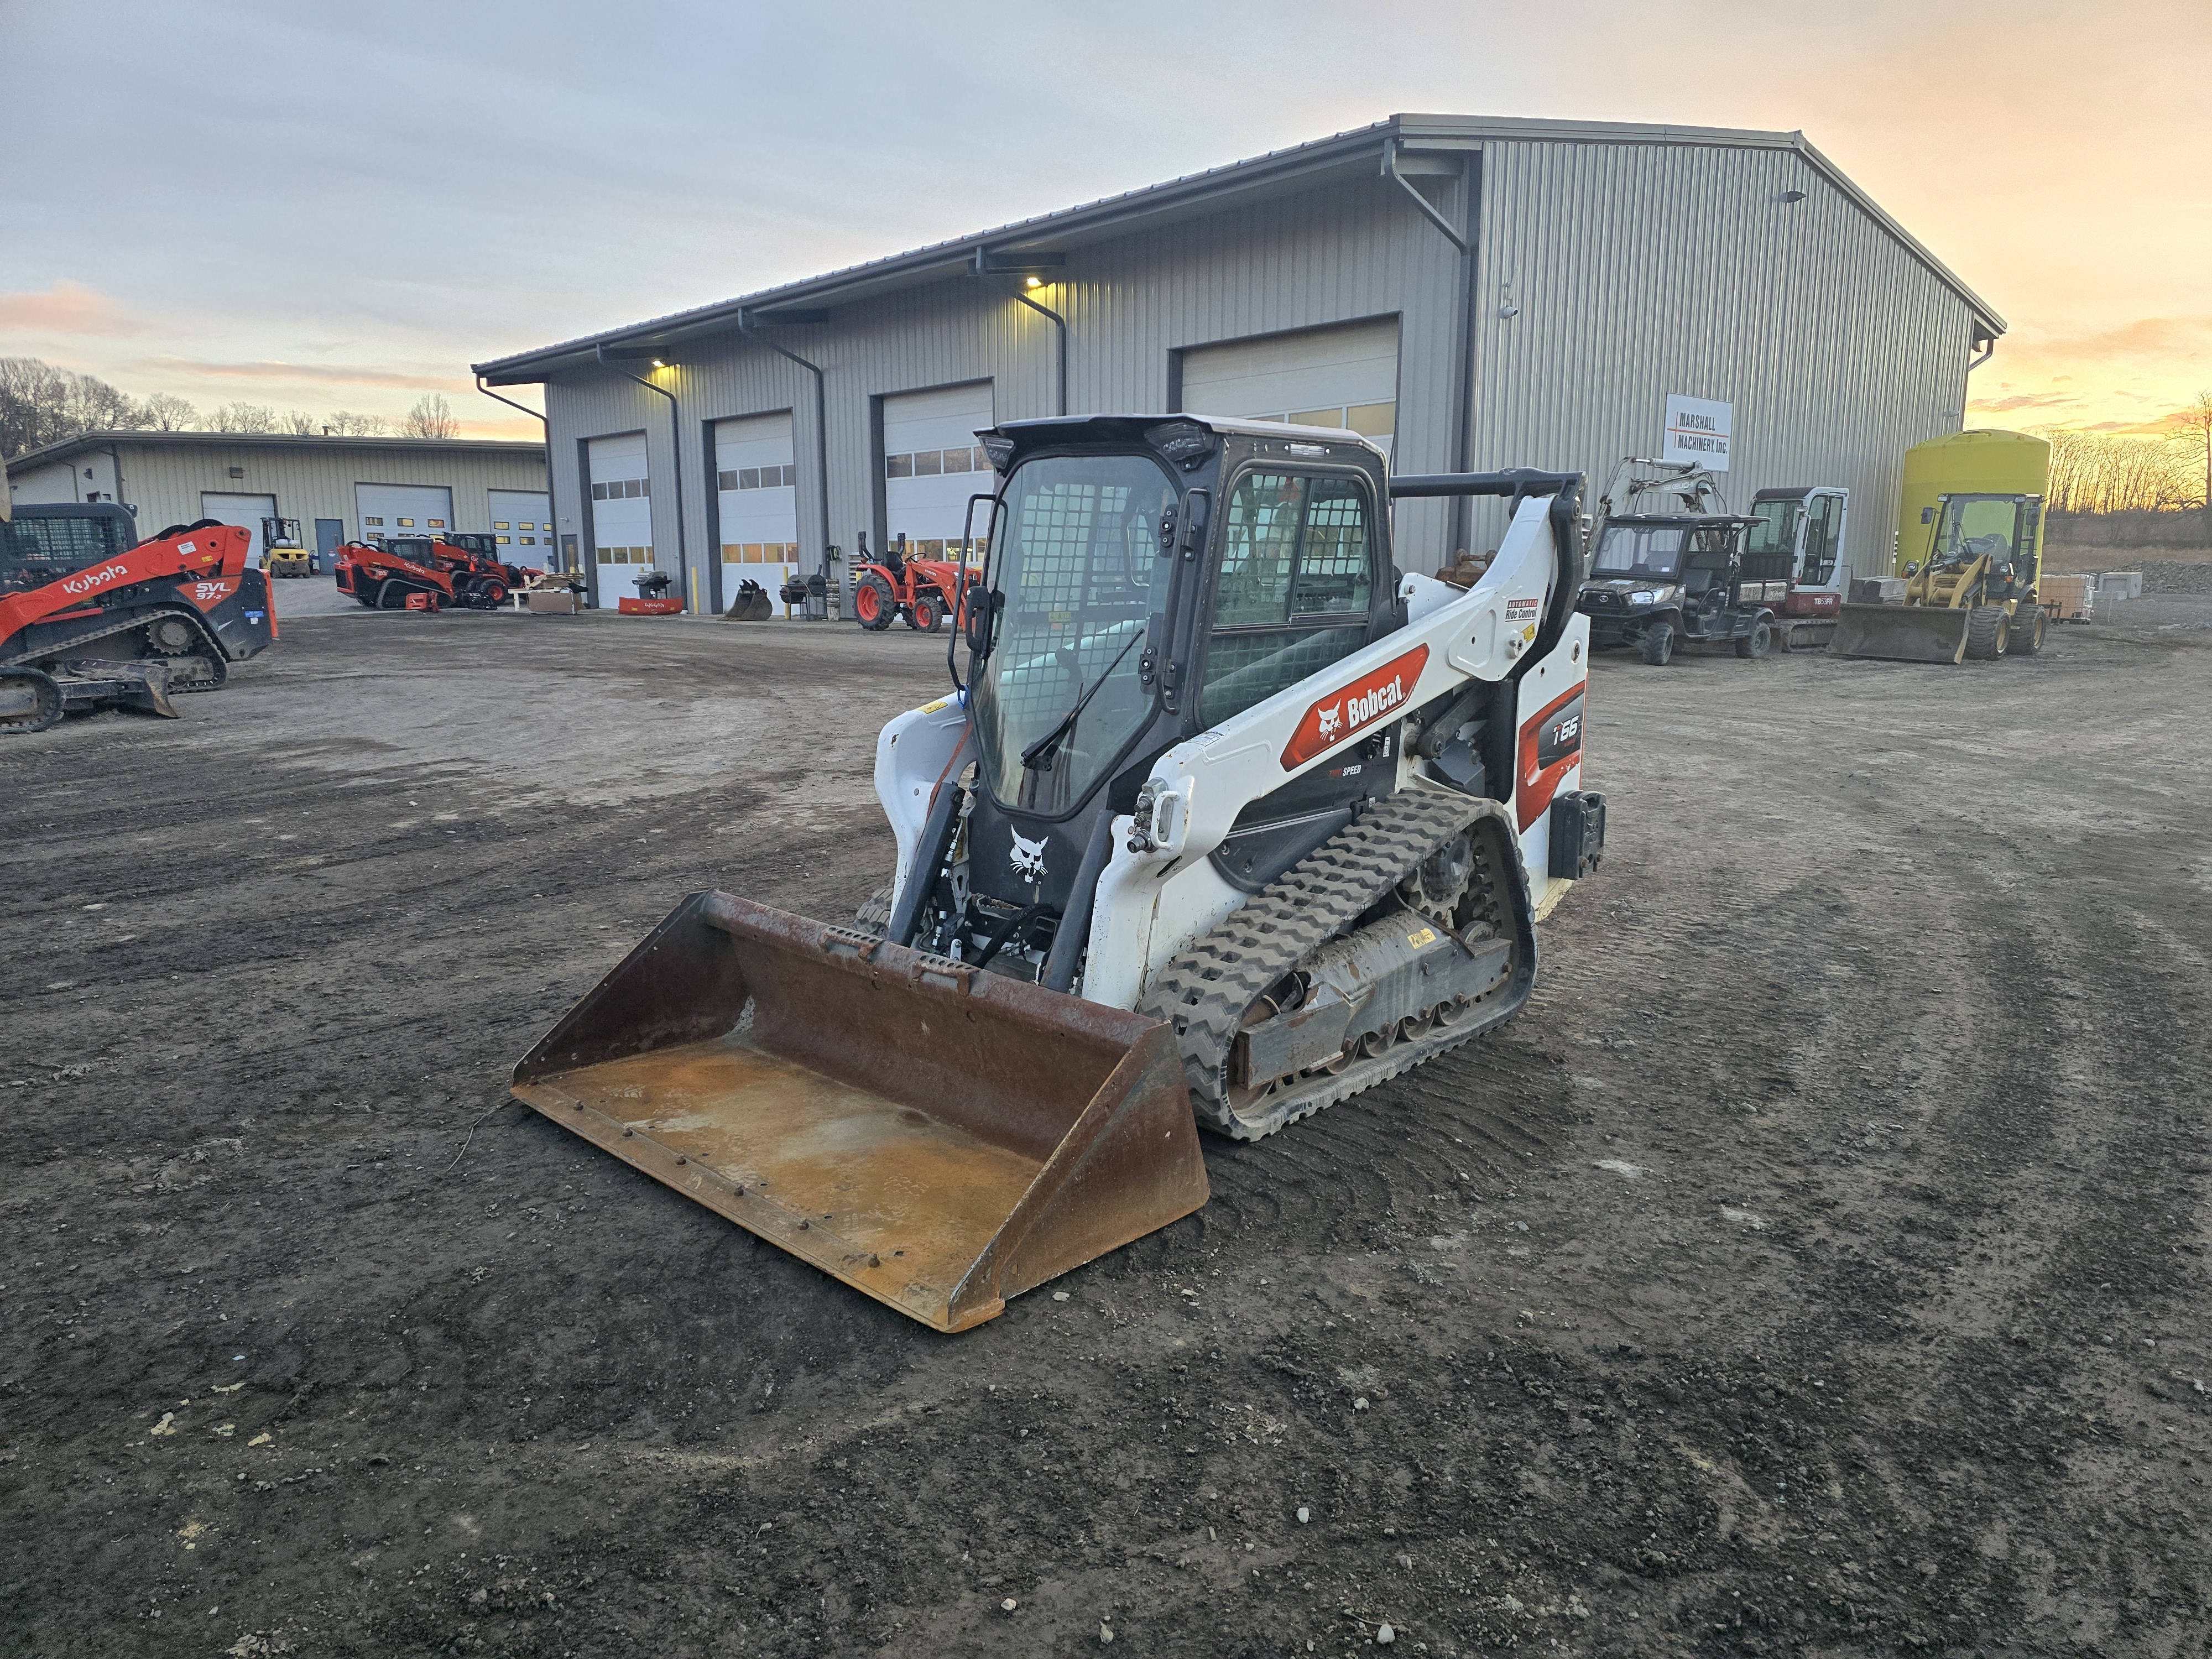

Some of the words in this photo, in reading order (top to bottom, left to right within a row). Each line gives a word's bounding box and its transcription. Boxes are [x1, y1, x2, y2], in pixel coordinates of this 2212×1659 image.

[1679, 412, 1715, 431] MARSHALL
[1716, 439, 1728, 454] Inc.
[404, 561, 425, 574] Kubota
[62, 565, 128, 593] Kubota
[195, 582, 231, 592] SVL
[1505, 609, 1517, 619] Ride
[1519, 608, 1537, 618] Control
[1347, 674, 1402, 729] Bobcat
[1553, 714, 1579, 746] T66
[1342, 764, 1361, 776] SPEED
